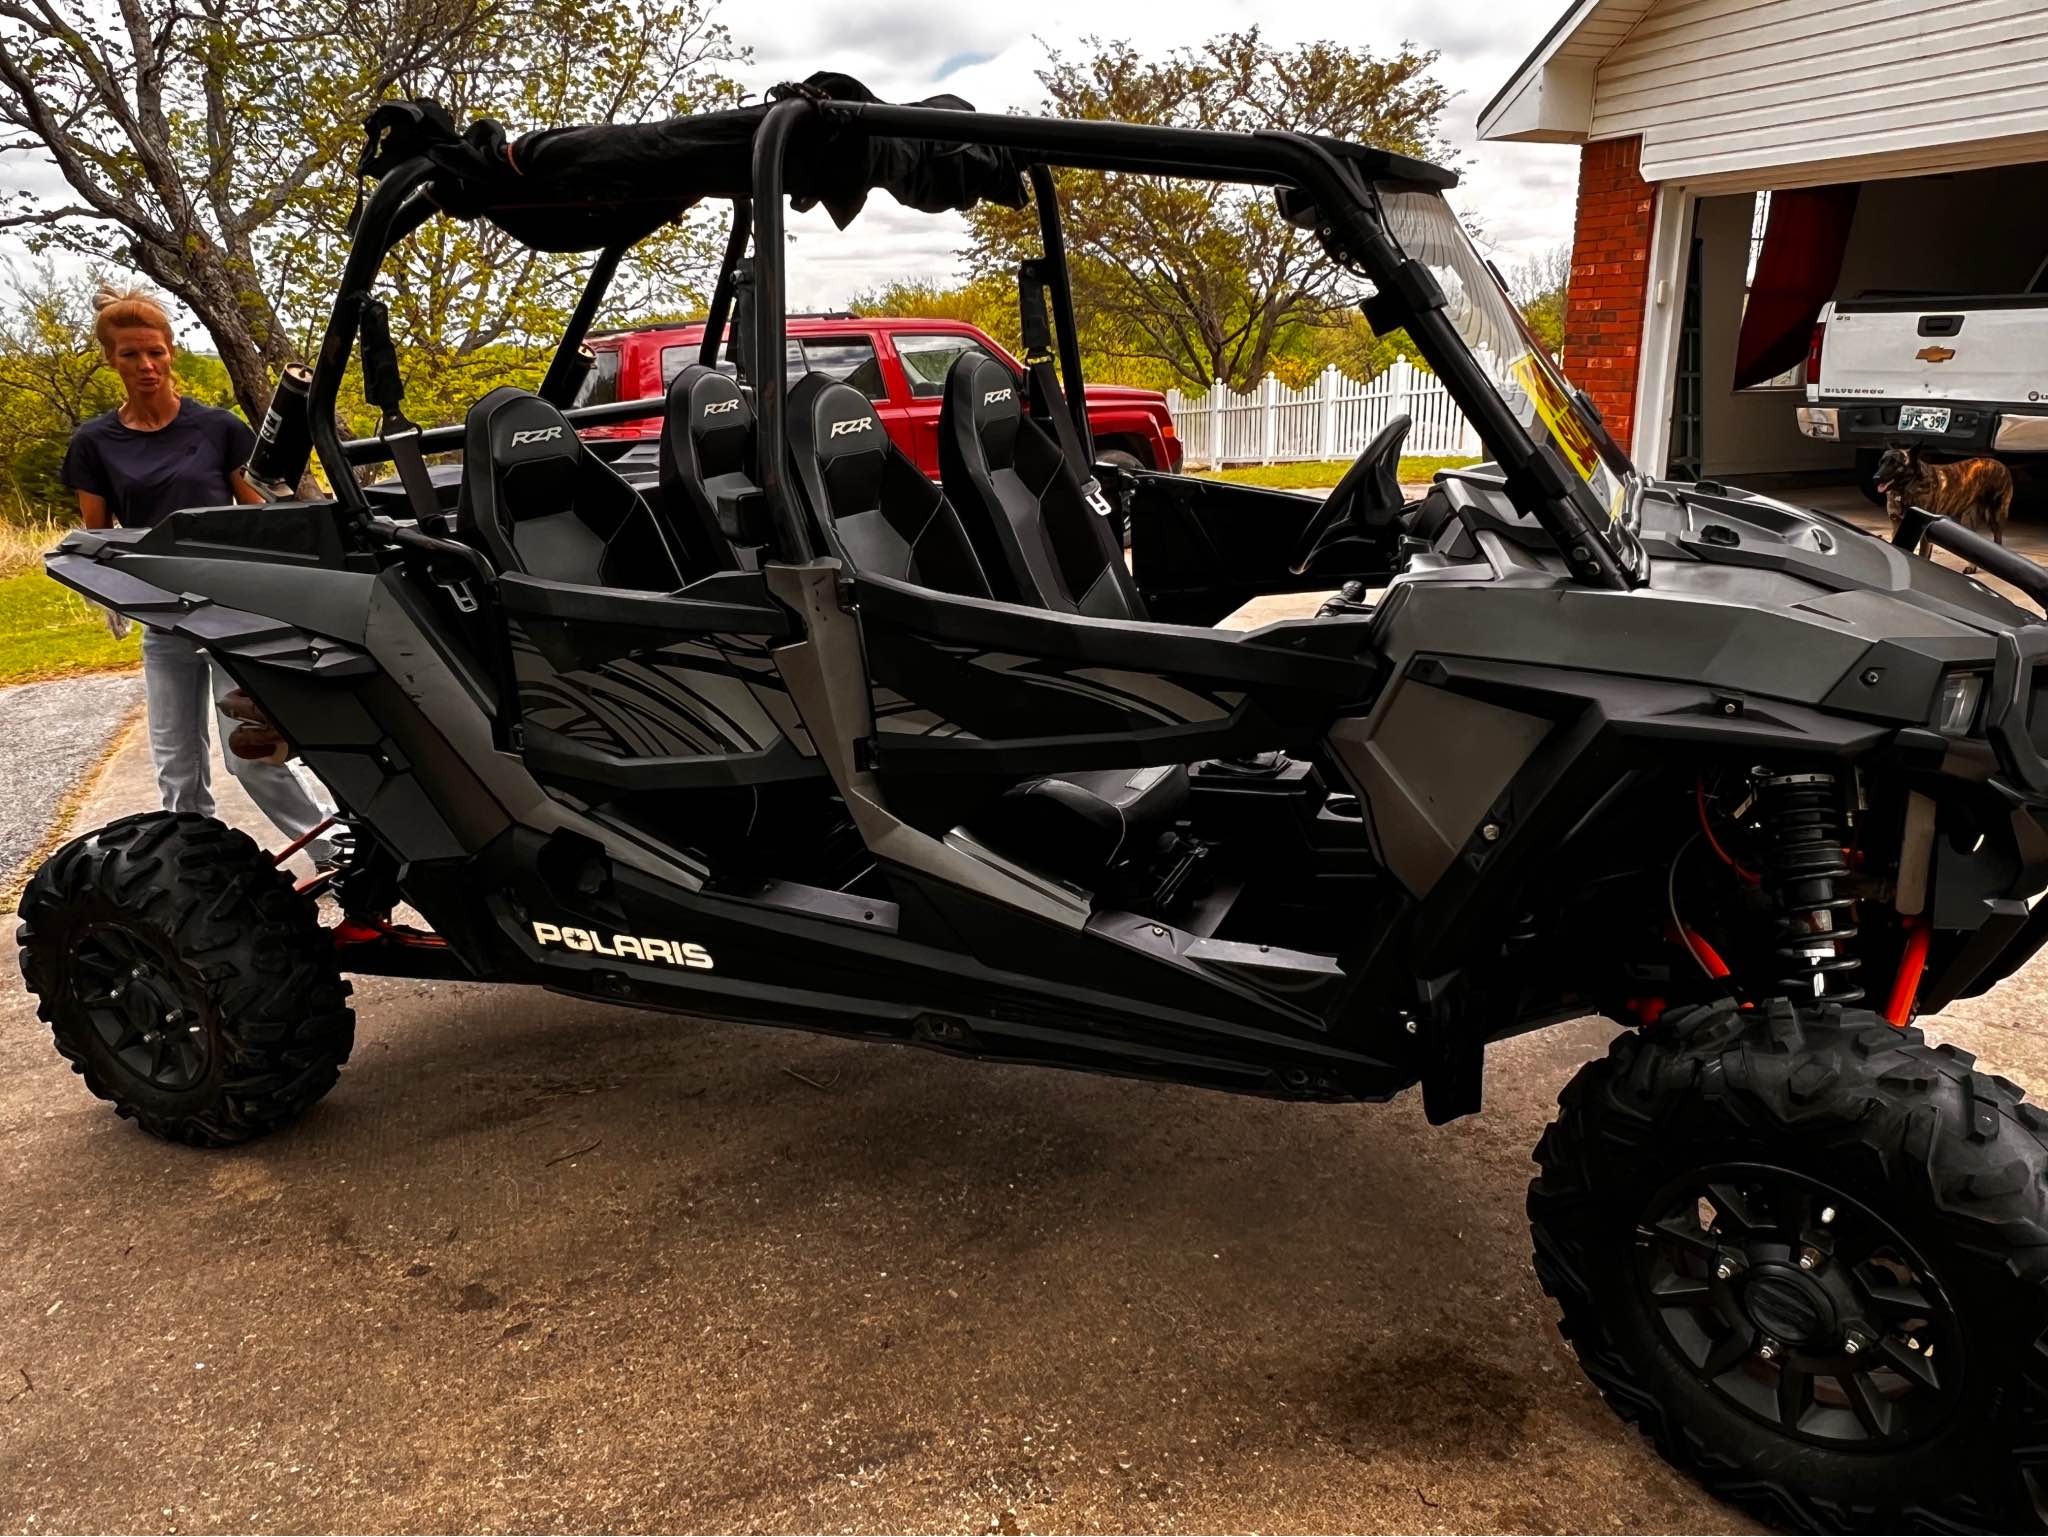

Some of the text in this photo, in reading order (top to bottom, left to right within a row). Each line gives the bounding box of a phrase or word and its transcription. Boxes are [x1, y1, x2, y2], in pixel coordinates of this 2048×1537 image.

[703, 399, 739, 418] RZR
[984, 388, 1012, 407] RZR
[511, 426, 562, 448] RZR
[830, 416, 872, 439] RZR
[532, 921, 715, 970] POLARIS
